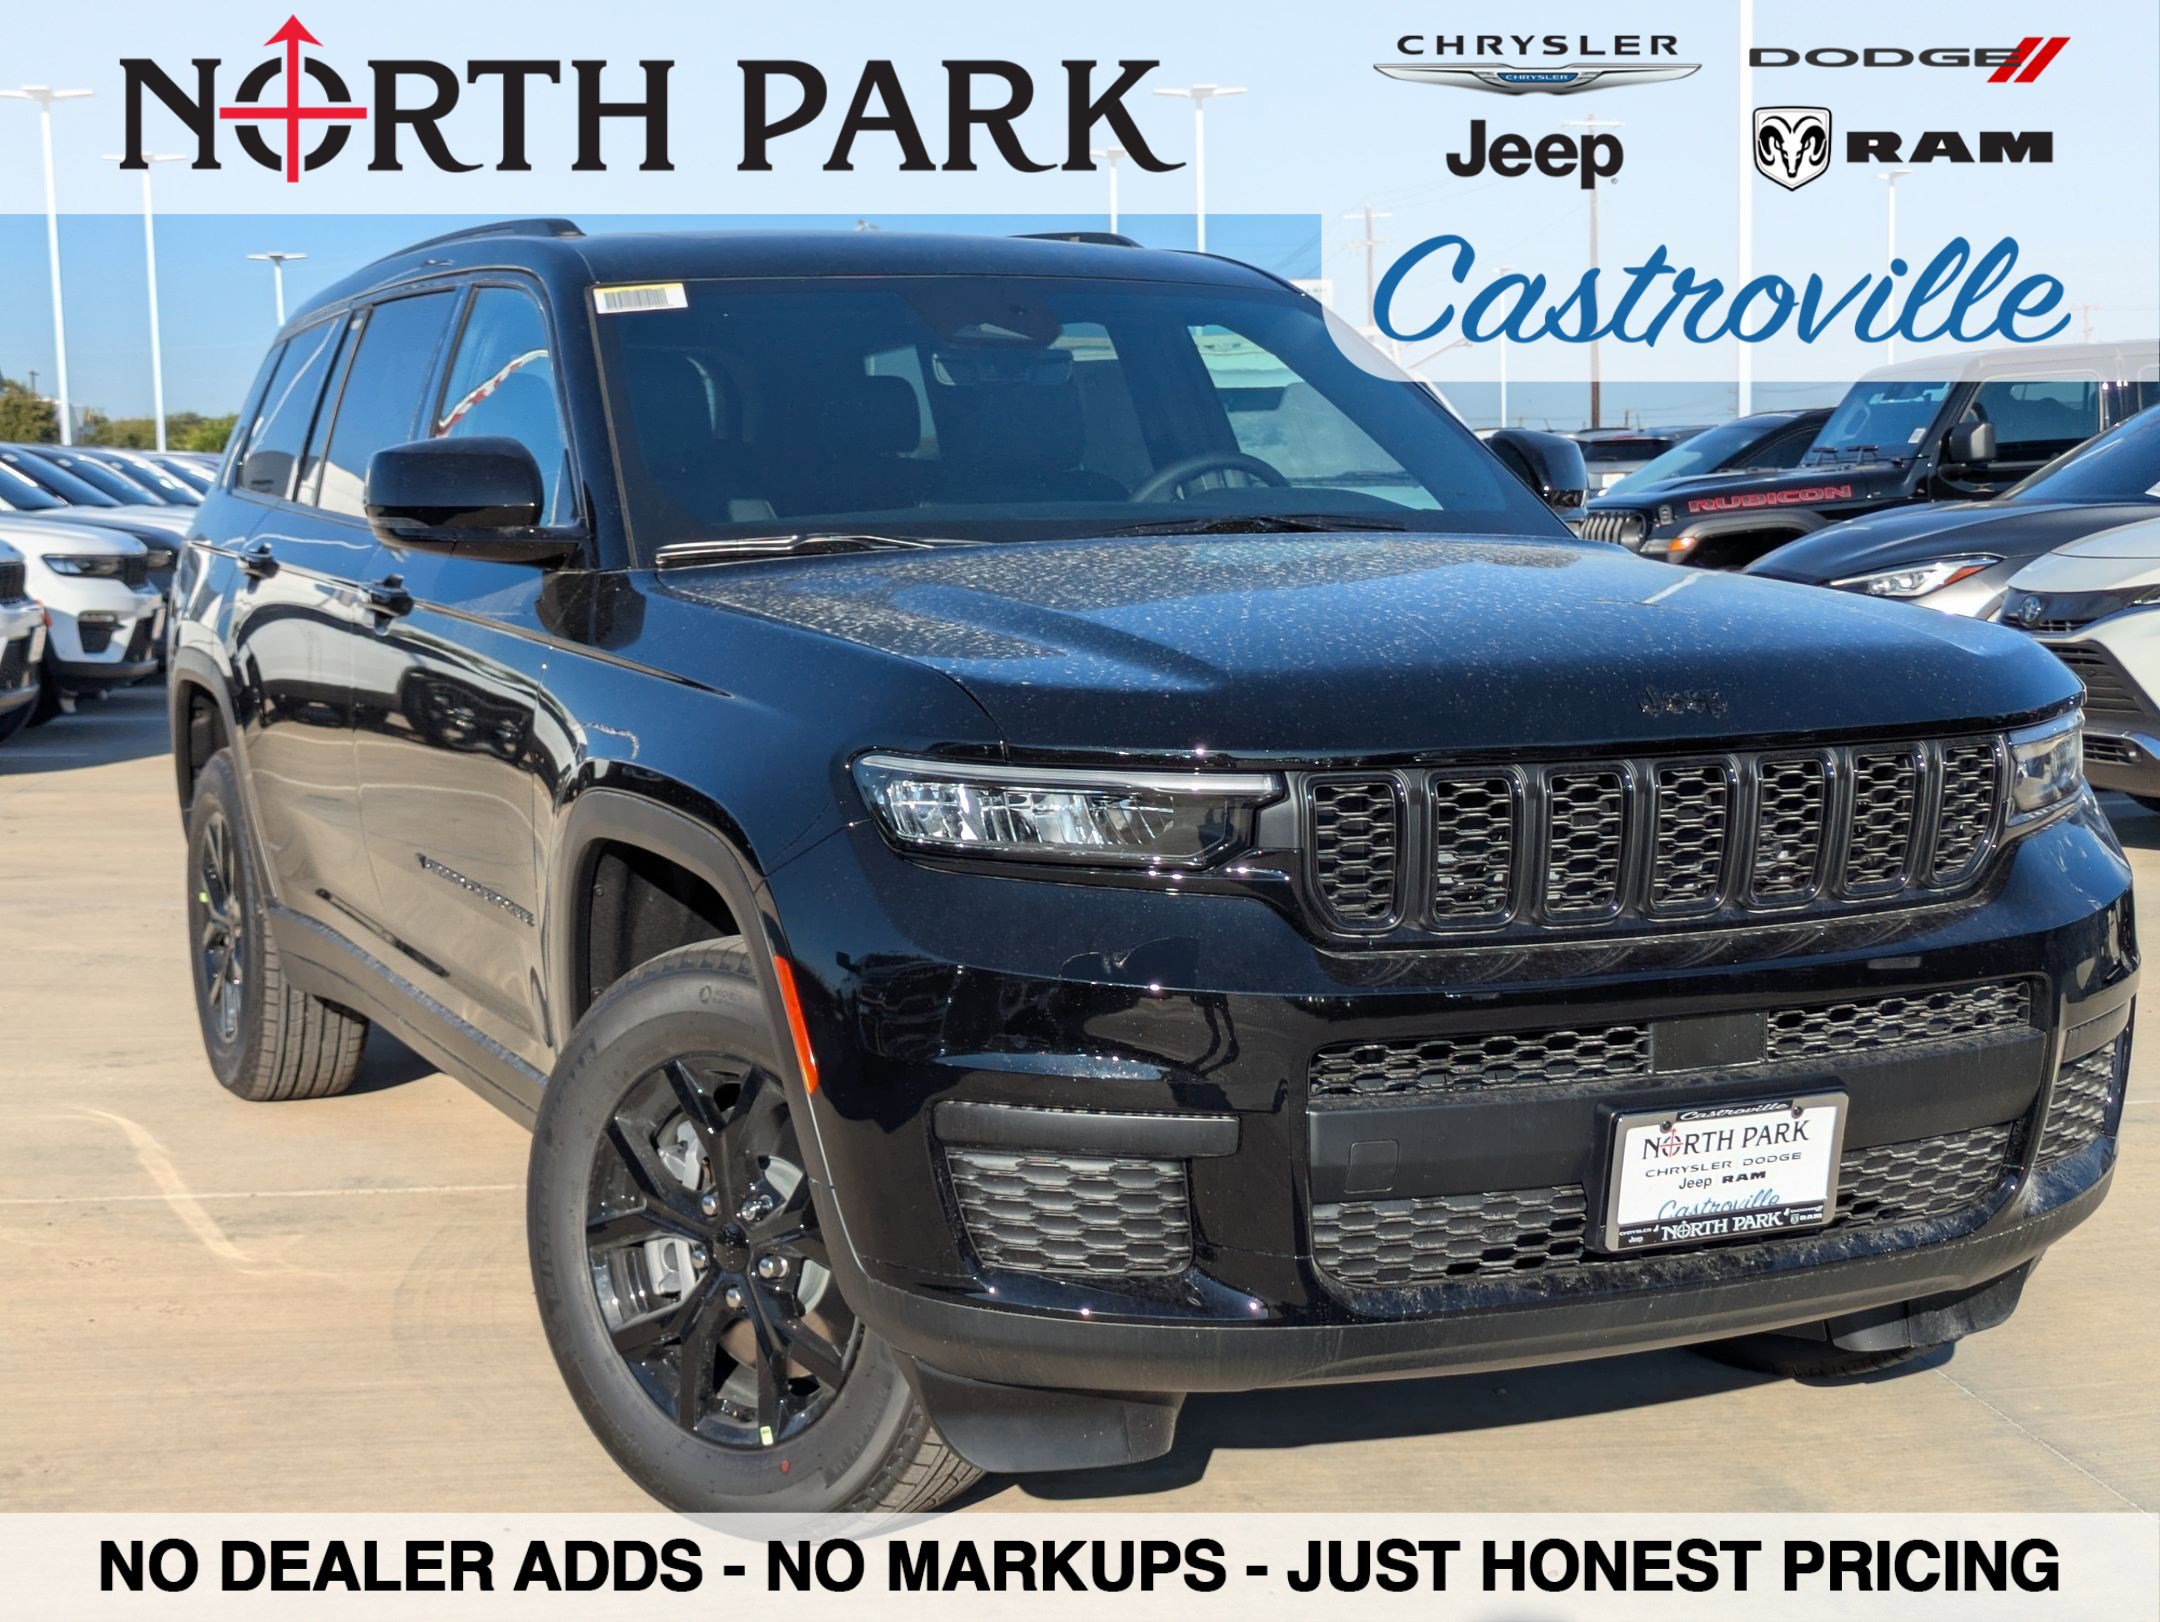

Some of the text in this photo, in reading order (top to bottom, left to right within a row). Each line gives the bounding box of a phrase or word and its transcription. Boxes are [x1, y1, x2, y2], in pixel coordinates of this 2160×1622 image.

[1688, 485, 1852, 512] RUBICON
[1679, 1101, 1790, 1121] Castroville
[1641, 1119, 1811, 1160] NORTH PARK
[1645, 1151, 1803, 1178] CHRYSLER DODGE
[1678, 1170, 1767, 1190] Jeep RAM
[1661, 1211, 1784, 1241] NORTH PARK
